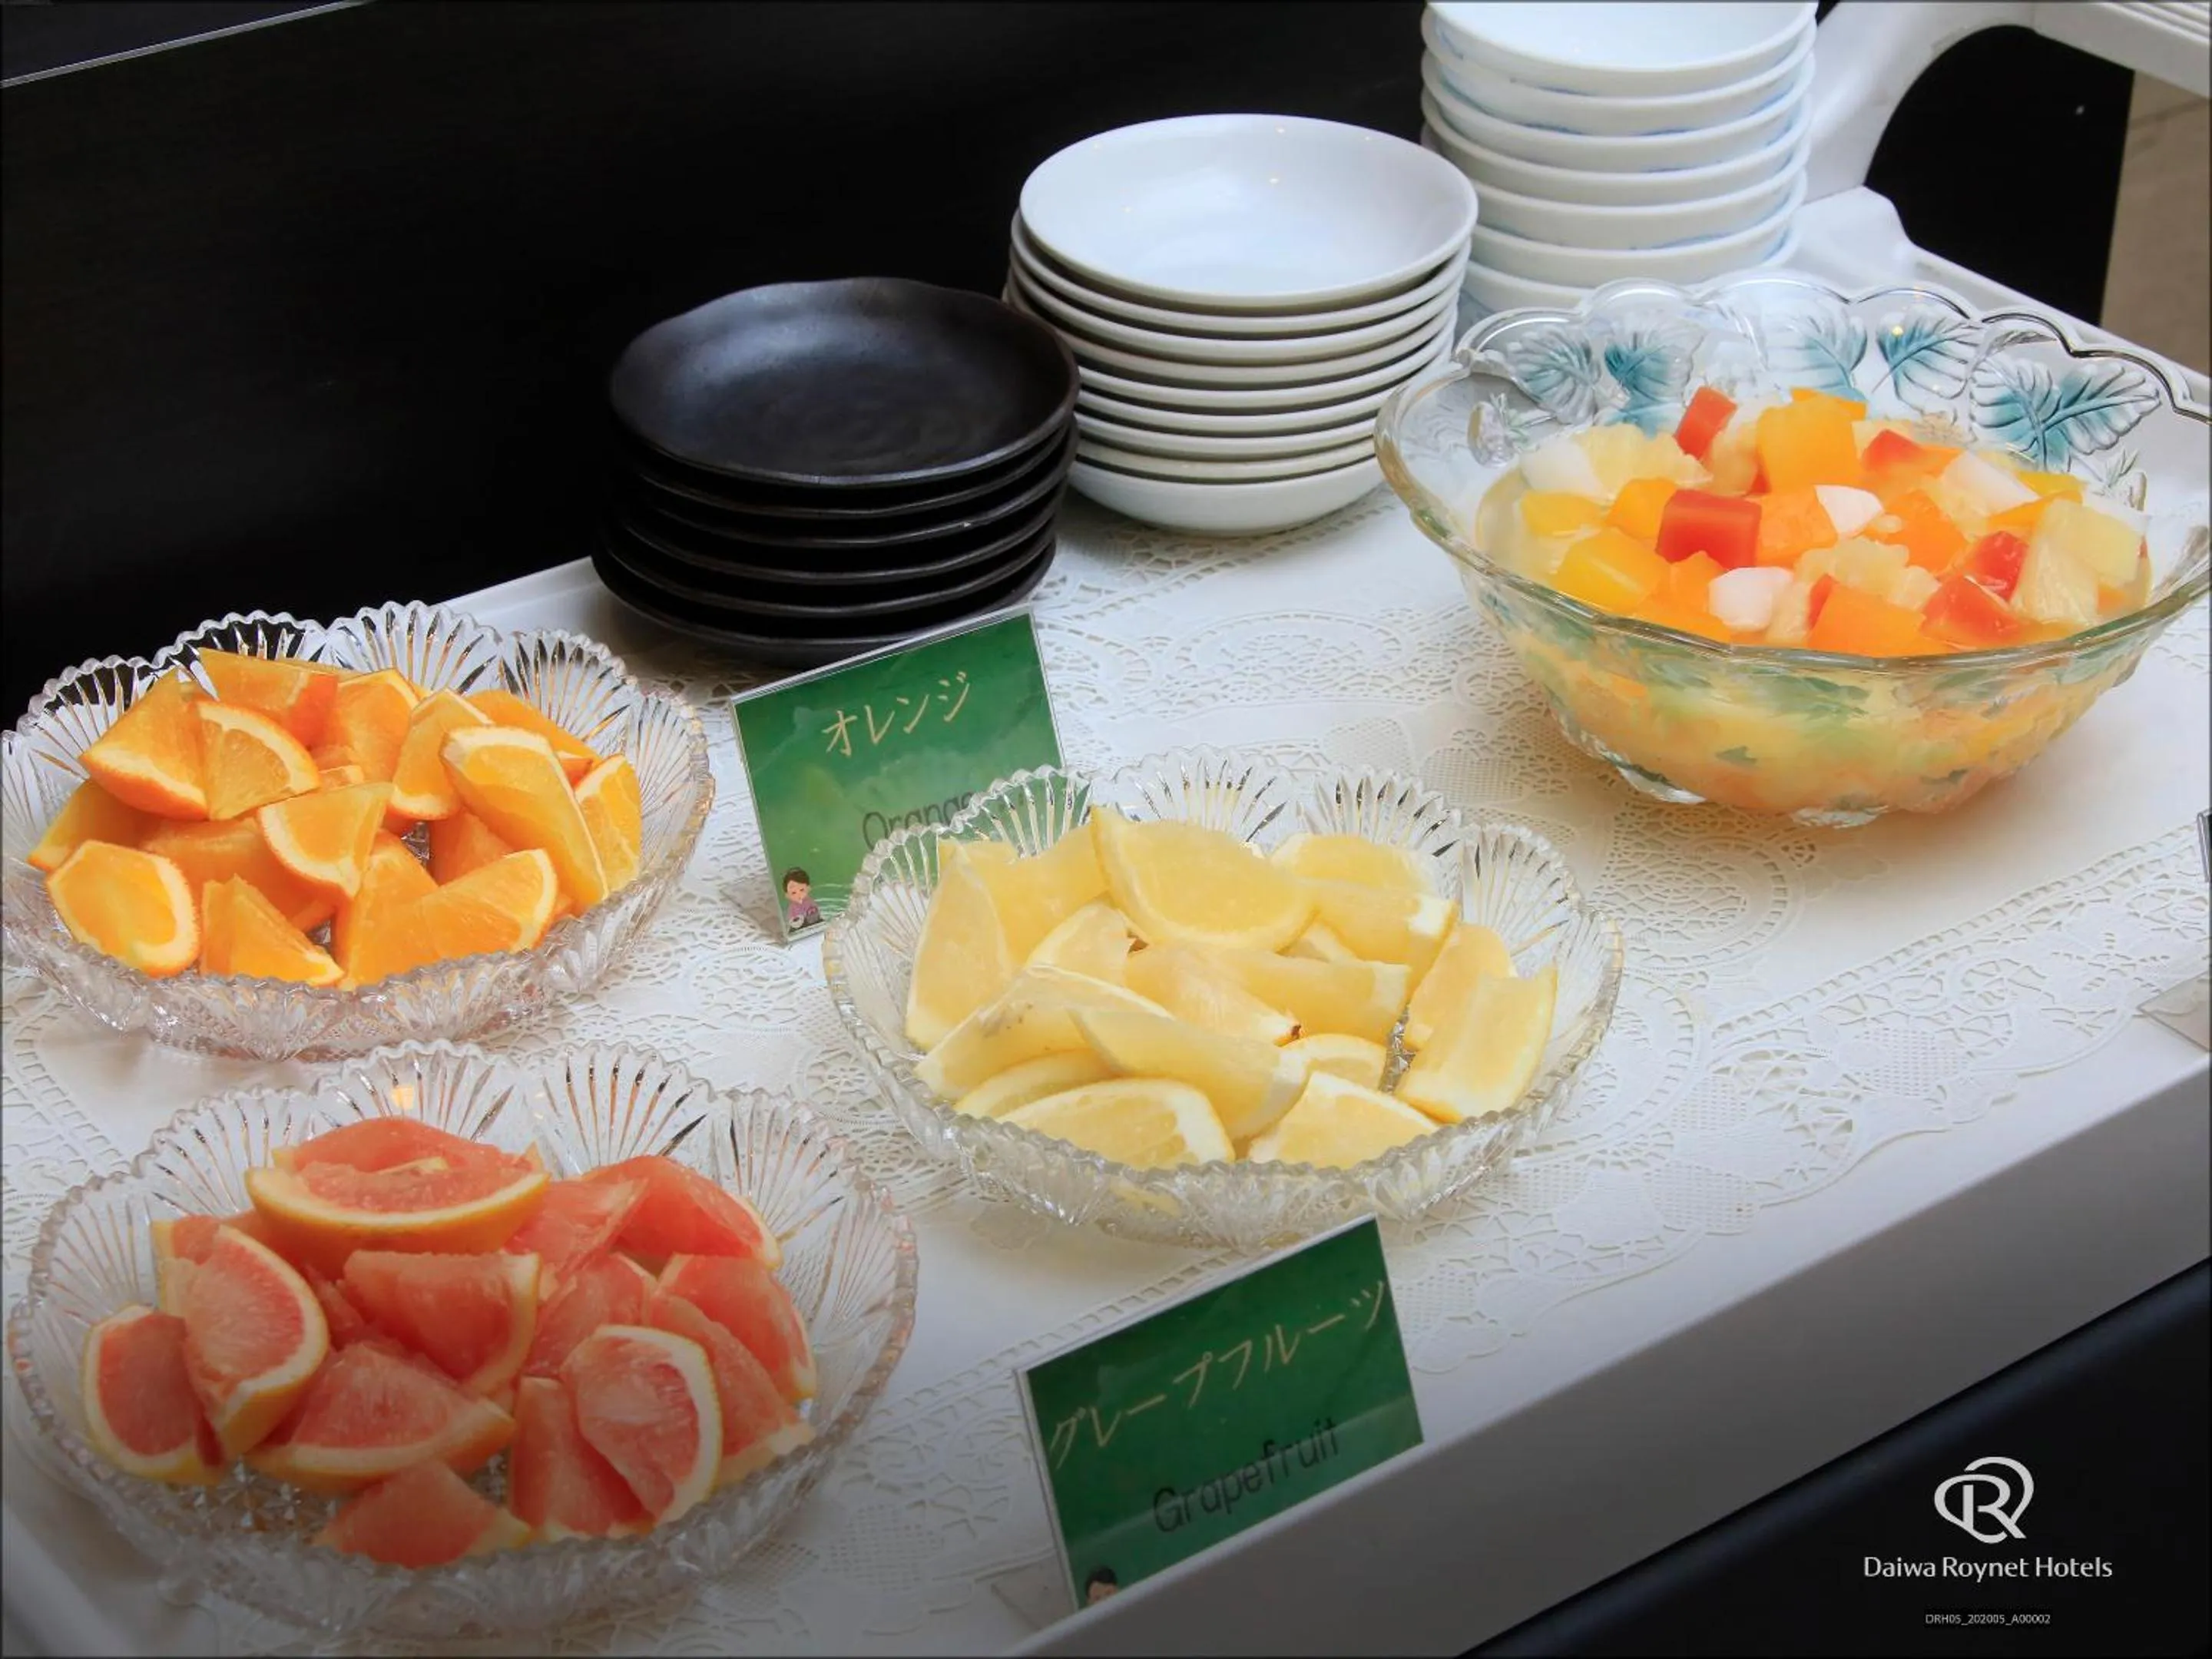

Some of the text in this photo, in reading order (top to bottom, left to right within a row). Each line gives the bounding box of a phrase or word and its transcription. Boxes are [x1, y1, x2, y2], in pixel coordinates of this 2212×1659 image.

[821, 671, 970, 757] オレンジ
[1049, 1280, 1383, 1470] グレープフルーツ
[1154, 1418, 1338, 1532] Grapefruit
